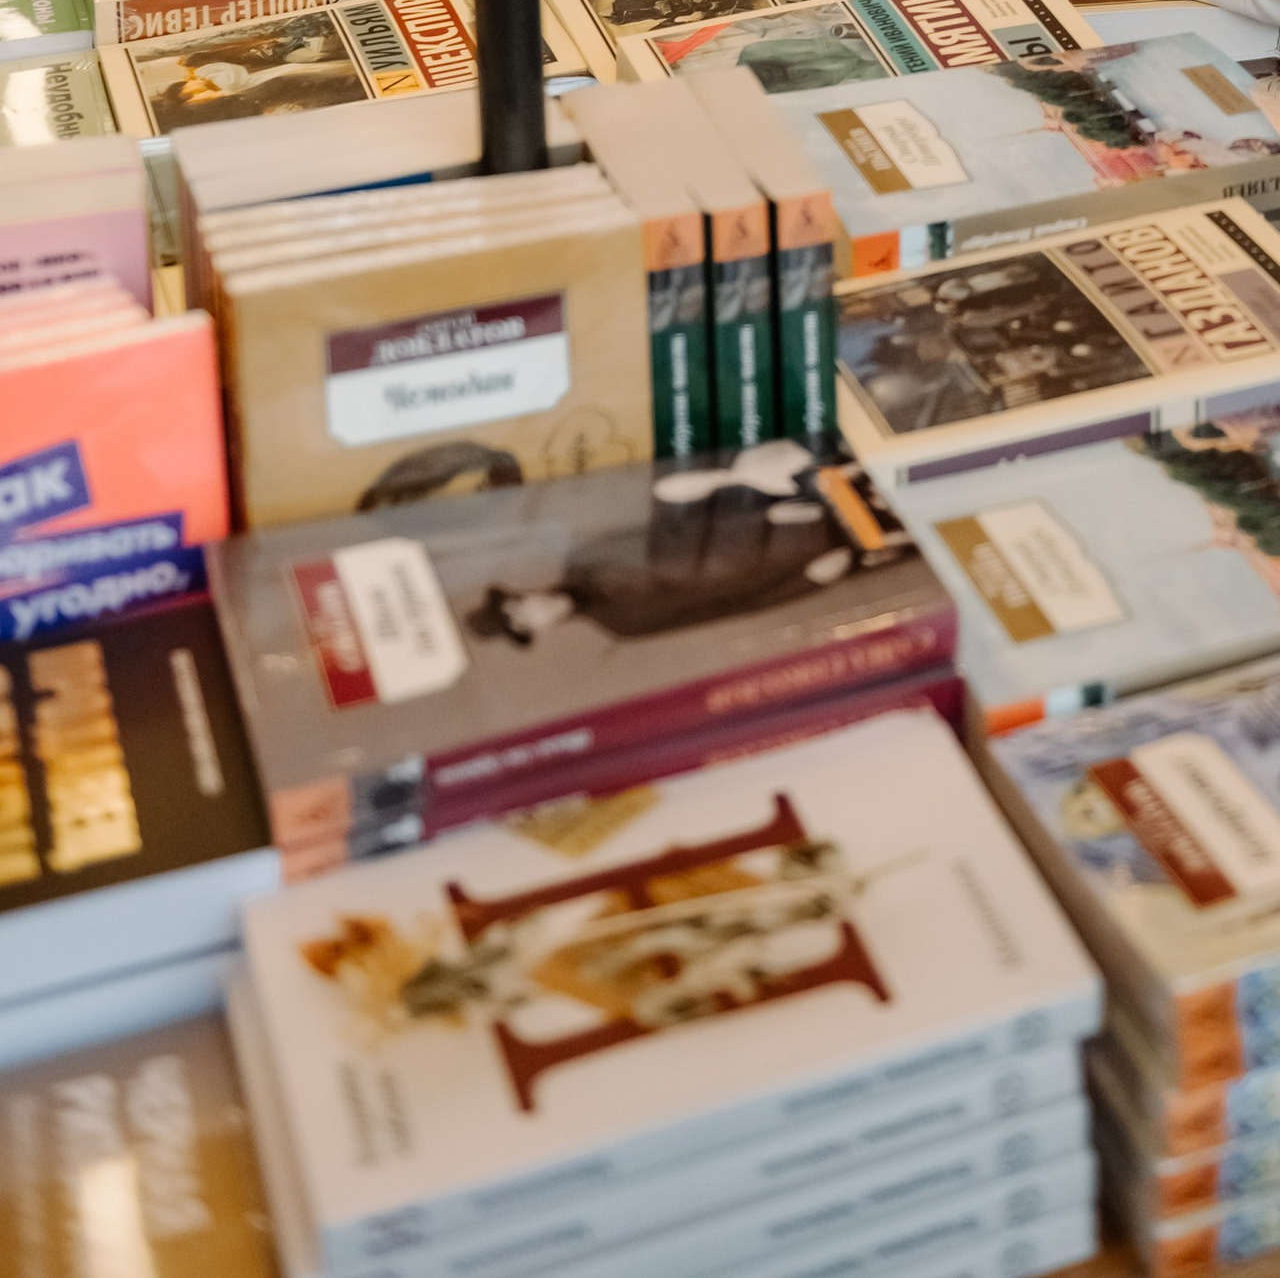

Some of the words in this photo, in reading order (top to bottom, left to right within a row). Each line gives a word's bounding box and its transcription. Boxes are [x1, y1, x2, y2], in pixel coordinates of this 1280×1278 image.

[127, 6, 214, 41] ТЕВИС
[343, 1, 409, 72] УИЛЬЯМ
[1008, 35, 1053, 59] Ы
[1064, 239, 1187, 342] ГАЙТО
[1103, 223, 1275, 364] ГАЗДАНОВ
[0, 455, 75, 524] ак
